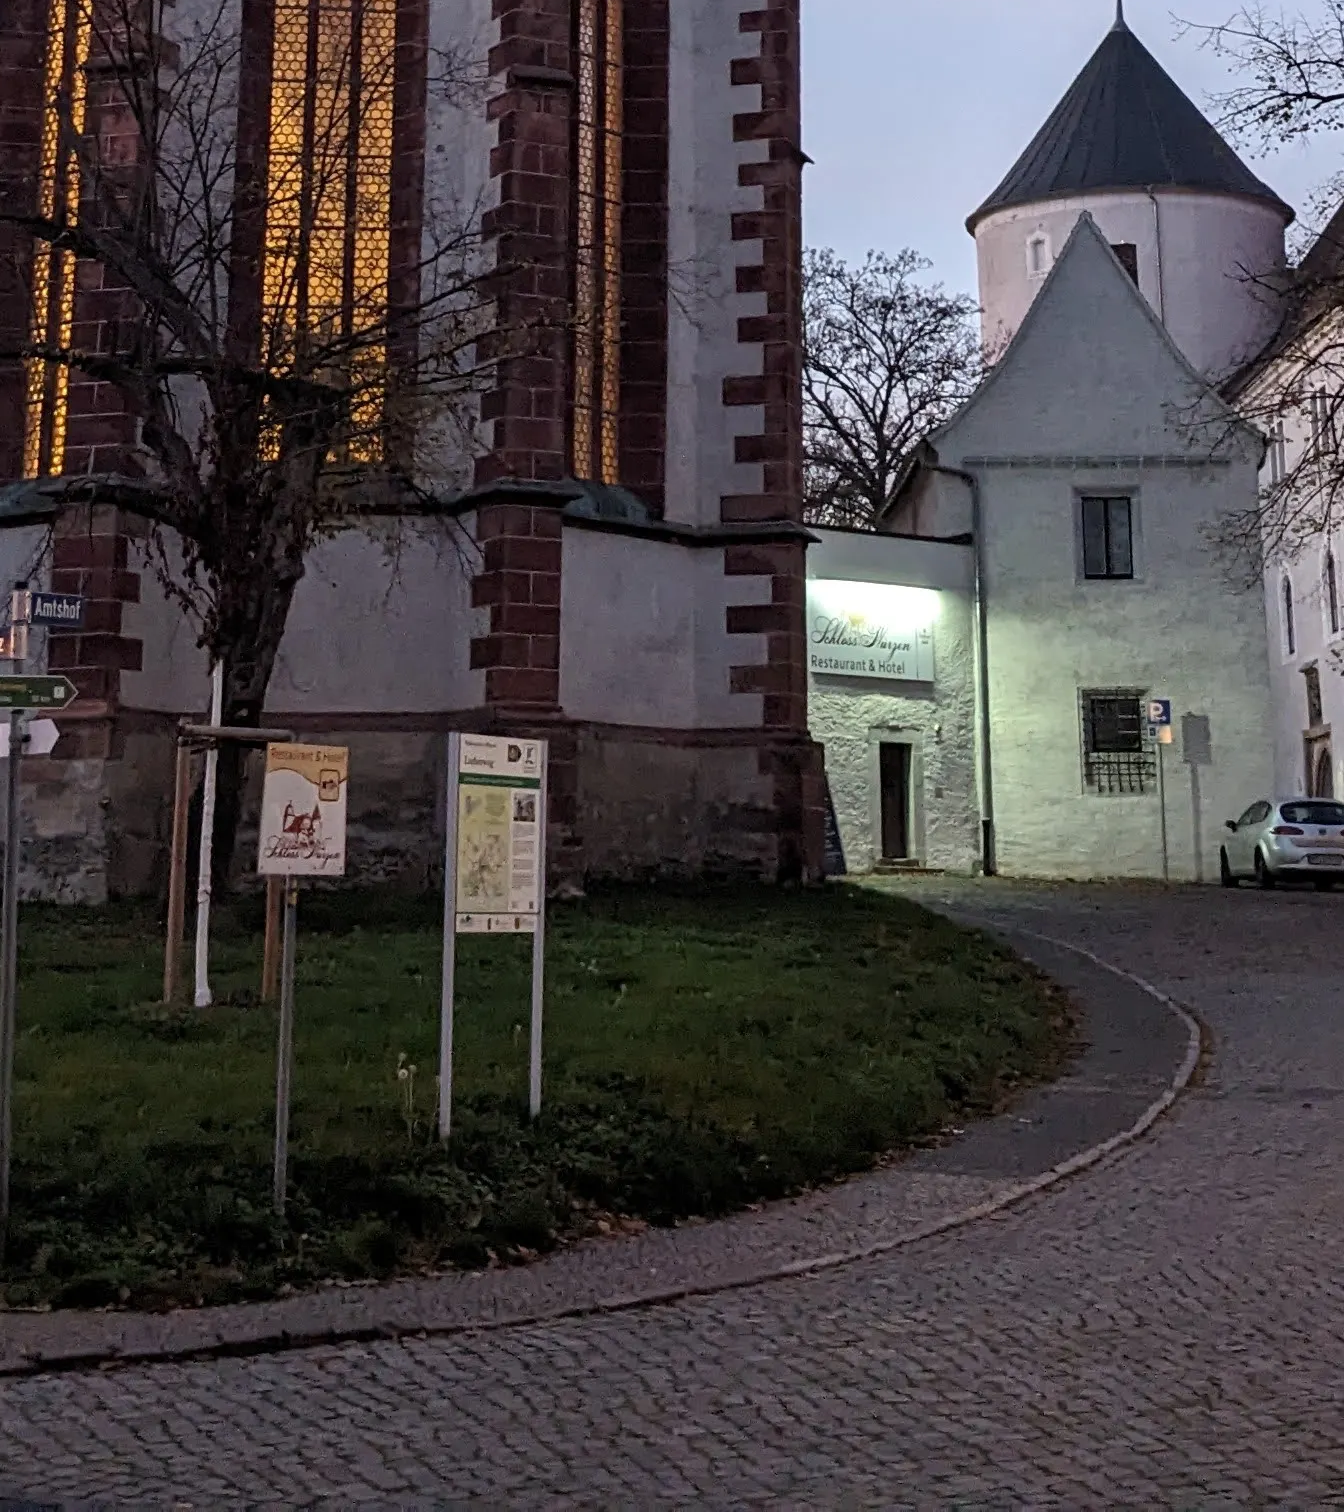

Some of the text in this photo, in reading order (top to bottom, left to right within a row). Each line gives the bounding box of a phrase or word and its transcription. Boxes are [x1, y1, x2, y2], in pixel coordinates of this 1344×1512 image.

[34, 596, 81, 620] Amtshof
[811, 615, 861, 645] Schloss
[811, 654, 905, 674] Restaurant & Hotel
